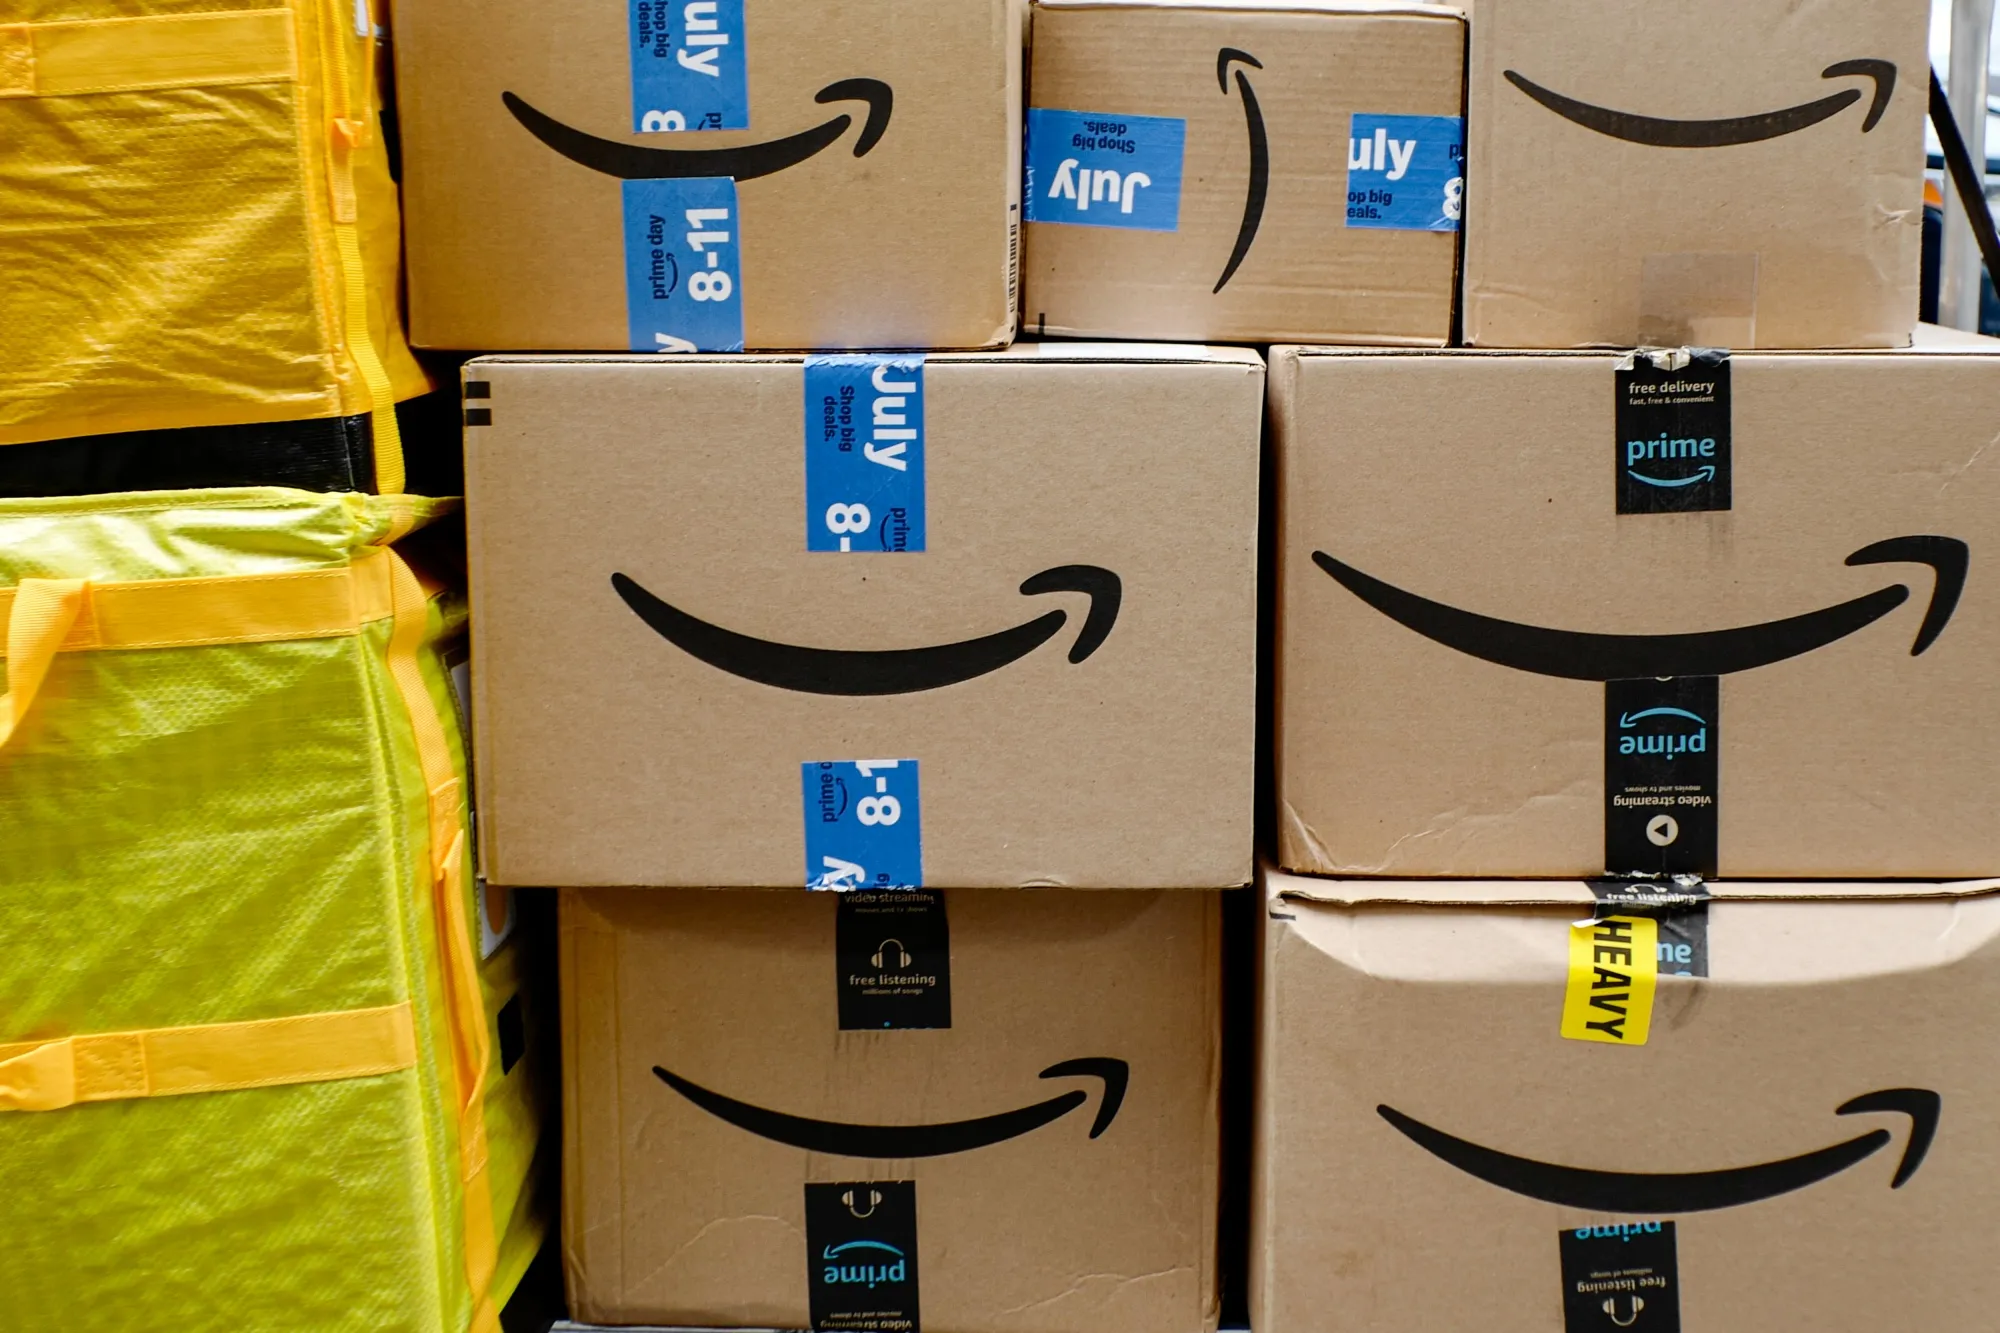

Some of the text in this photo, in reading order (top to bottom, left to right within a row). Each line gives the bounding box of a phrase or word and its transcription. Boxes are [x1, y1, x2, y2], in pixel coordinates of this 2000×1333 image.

[638, 1, 653, 48] deals.
[653, 0, 670, 57] hop big
[677, 1, 729, 77] uly
[1072, 133, 1136, 153] Shop big
[1083, 121, 1127, 137] deals.
[1348, 128, 1417, 181] uly
[1048, 158, 1151, 214] July
[1348, 189, 1393, 206] op big
[1347, 205, 1382, 219] eals.
[647, 214, 669, 300] prime day
[685, 208, 732, 302] 8-11
[1629, 380, 1715, 394] free delivery
[1629, 397, 1647, 405] fast,
[1665, 396, 1671, 404] &
[1672, 395, 1715, 403] convenient
[824, 395, 839, 442] deals.
[838, 385, 856, 452] Shop big
[863, 365, 917, 472] July
[1627, 432, 1716, 466] prime
[826, 502, 871, 552] 8-
[1619, 727, 1707, 761] prime
[818, 773, 838, 822] prime
[856, 759, 901, 826] 8-1
[1613, 795, 1712, 808] video streaming
[849, 973, 936, 987] free listening
[1585, 919, 1632, 1040] HEAVY
[823, 1259, 905, 1289] prime
[1577, 1276, 1666, 1294] free listening
